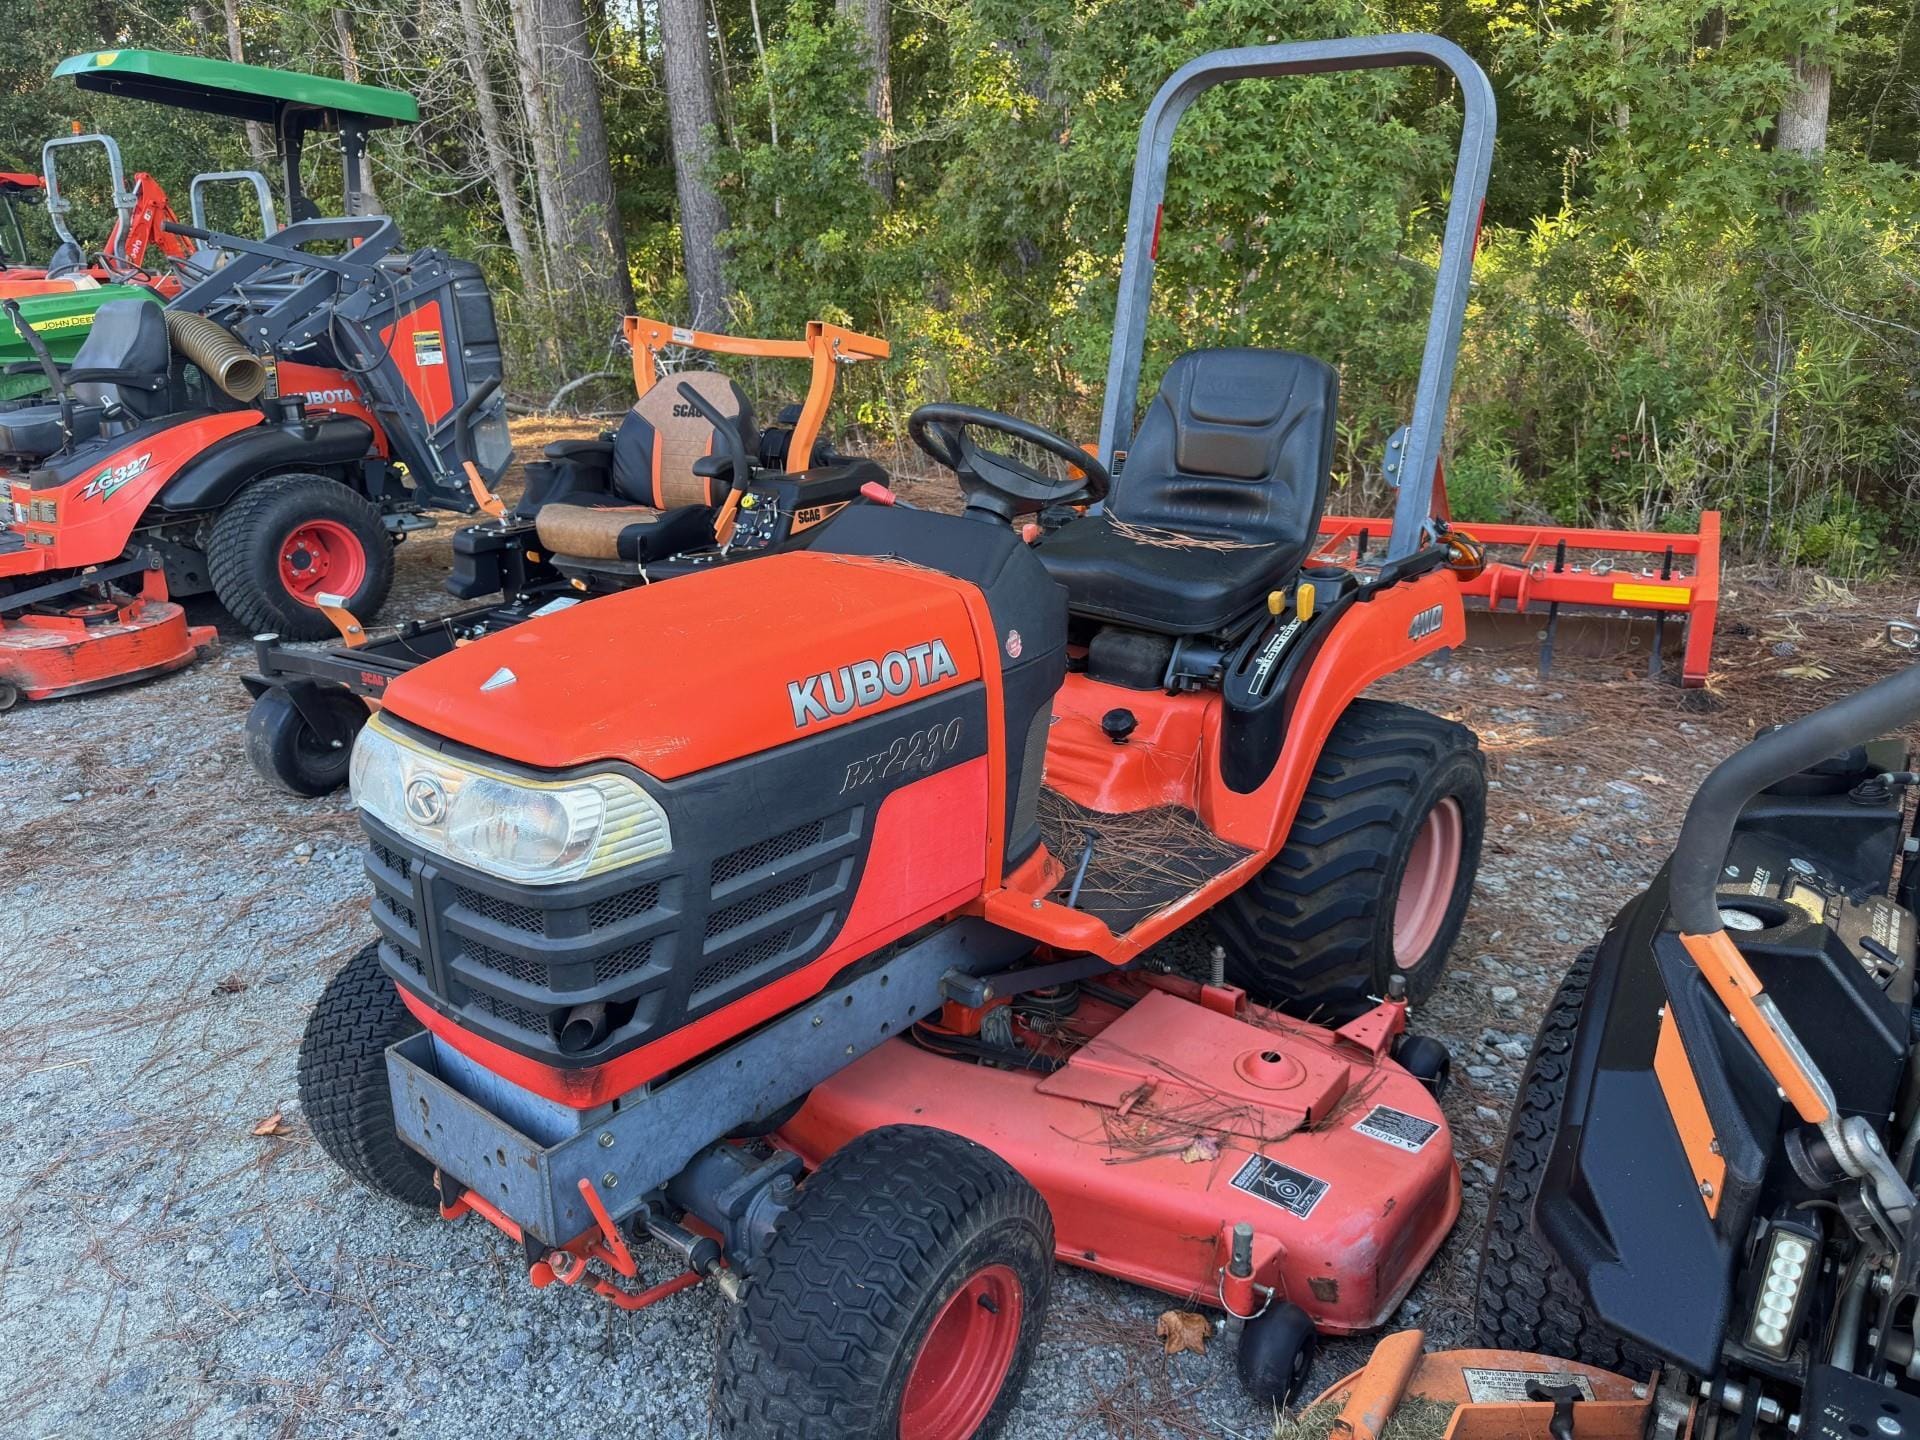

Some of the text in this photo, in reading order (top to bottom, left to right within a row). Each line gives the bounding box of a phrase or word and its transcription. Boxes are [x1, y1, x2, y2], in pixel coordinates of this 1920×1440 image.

[43, 316, 95, 329] JOHN DEE
[287, 389, 354, 405] UBOTA
[80, 452, 152, 499] ZG327
[797, 508, 821, 524] SCAG
[1408, 603, 1443, 641] 4WD
[361, 672, 384, 686] SCAG
[787, 638, 958, 728] KUBOTA
[839, 716, 964, 795] BX2230
[1357, 1125, 1402, 1144] CAUTION
